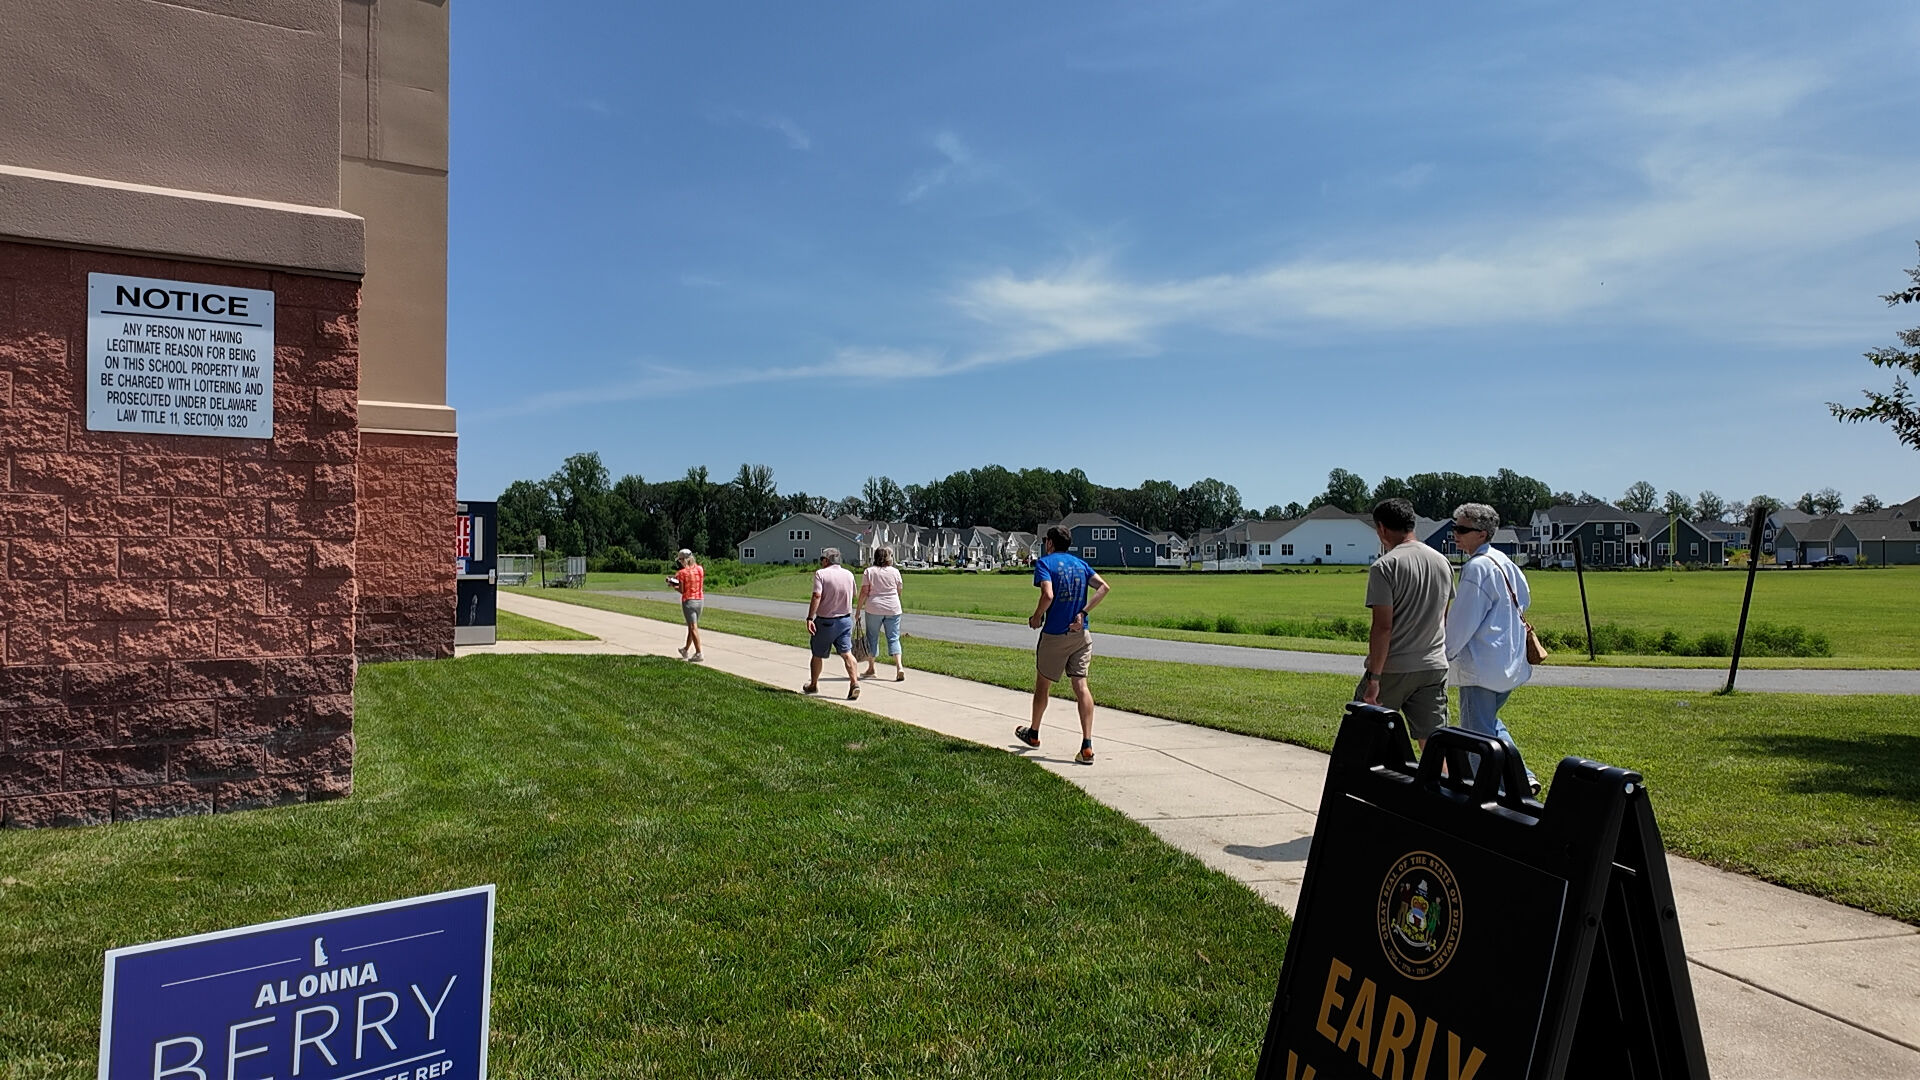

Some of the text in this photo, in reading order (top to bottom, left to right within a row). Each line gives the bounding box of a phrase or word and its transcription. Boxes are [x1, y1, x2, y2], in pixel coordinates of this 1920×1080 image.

[117, 286, 248, 317] NOTICE
[123, 323, 242, 344] ANY PERSON NOT HAVING
[107, 339, 256, 361] LEGITIMATE REASON FOR BEING
[105, 356, 260, 378] ON THIS SCHOOL PROPERTY MAY
[101, 373, 263, 395] BE CHARGED WITH LOITERING AND
[107, 391, 257, 411] PROSECUTED UNDER DELAWARE
[117, 409, 248, 428] LAW TITLE 11, SECTION 1320
[1380, 856, 1459, 969] GREAT SEAL OF THE STATE OF DELAWARE
[255, 962, 378, 1008] ALONNA
[154, 975, 457, 1080] BERRY
[1316, 957, 1487, 1080] EARLY
[415, 1060, 453, 1080] REP
